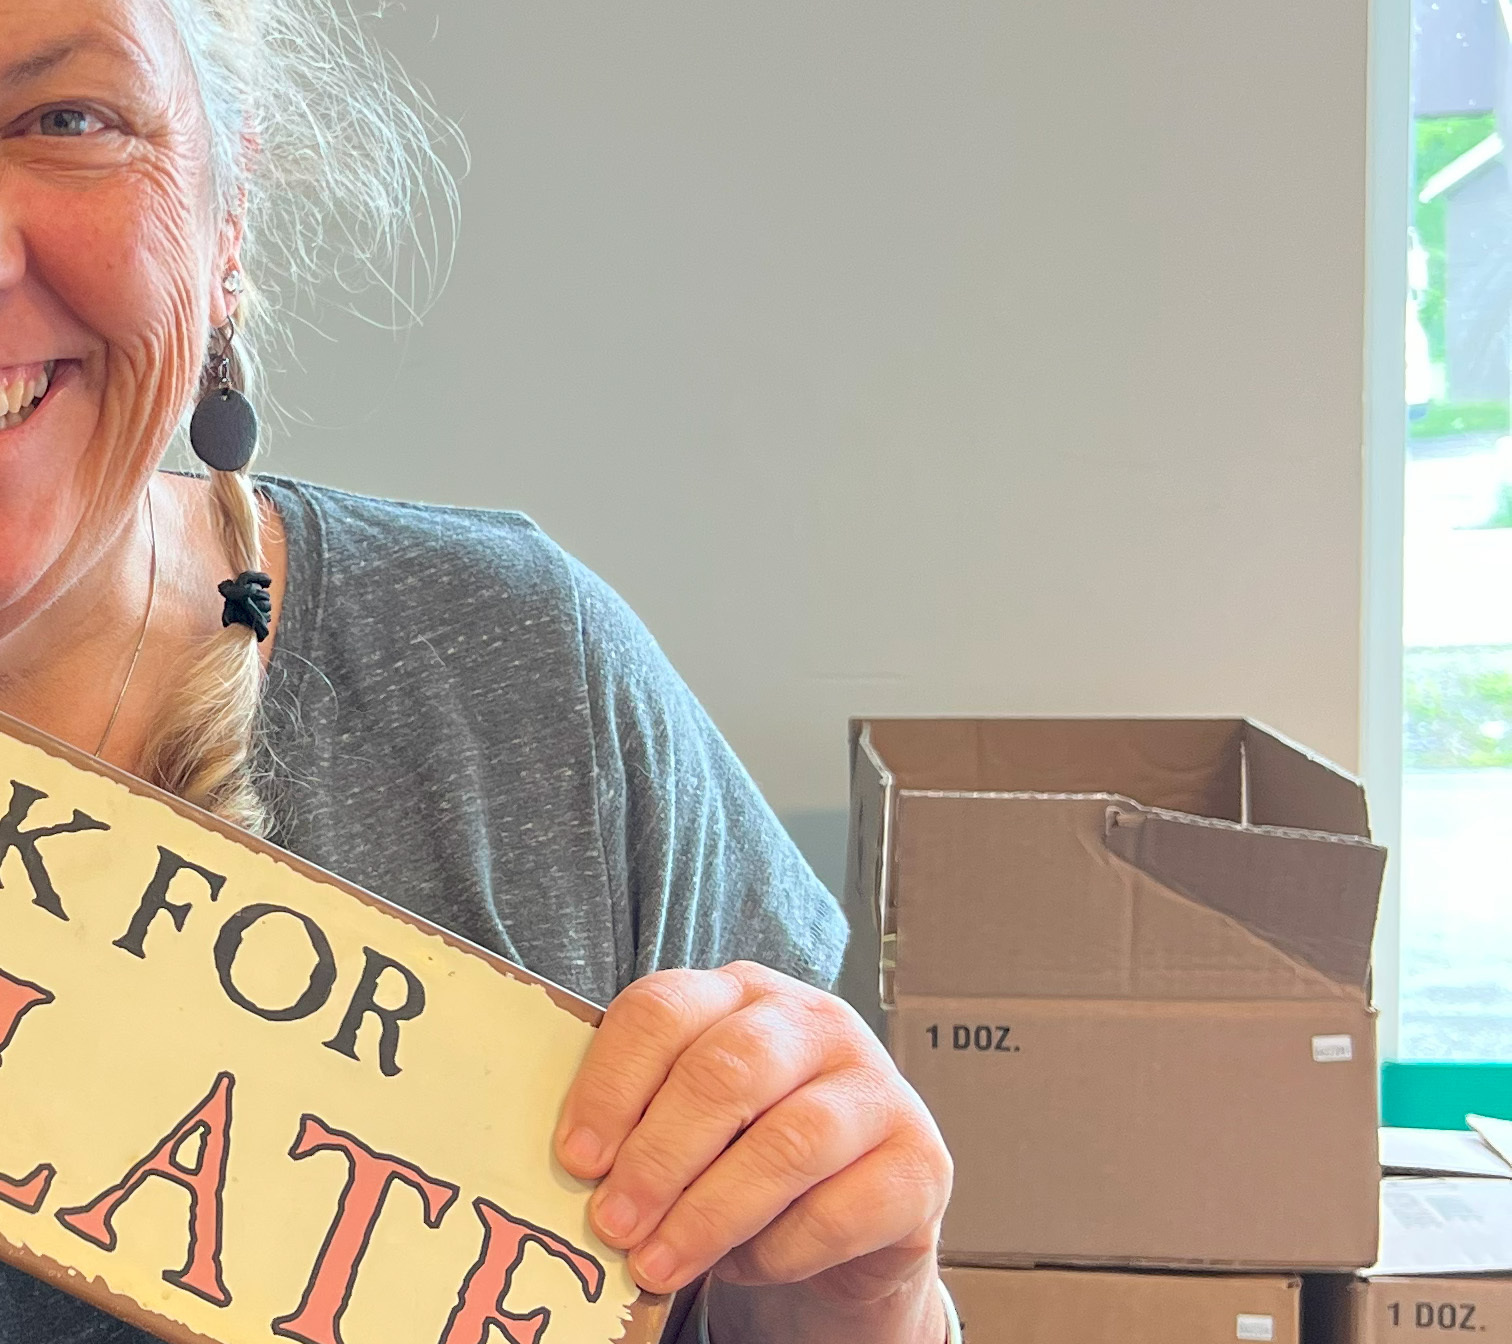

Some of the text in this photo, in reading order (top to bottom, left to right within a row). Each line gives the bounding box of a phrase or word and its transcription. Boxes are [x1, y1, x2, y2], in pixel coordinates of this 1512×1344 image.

[113, 844, 426, 1078] FOR
[926, 1024, 1021, 1053] 1 DOZ.
[1387, 1301, 1487, 1331] 1 DOZ.
